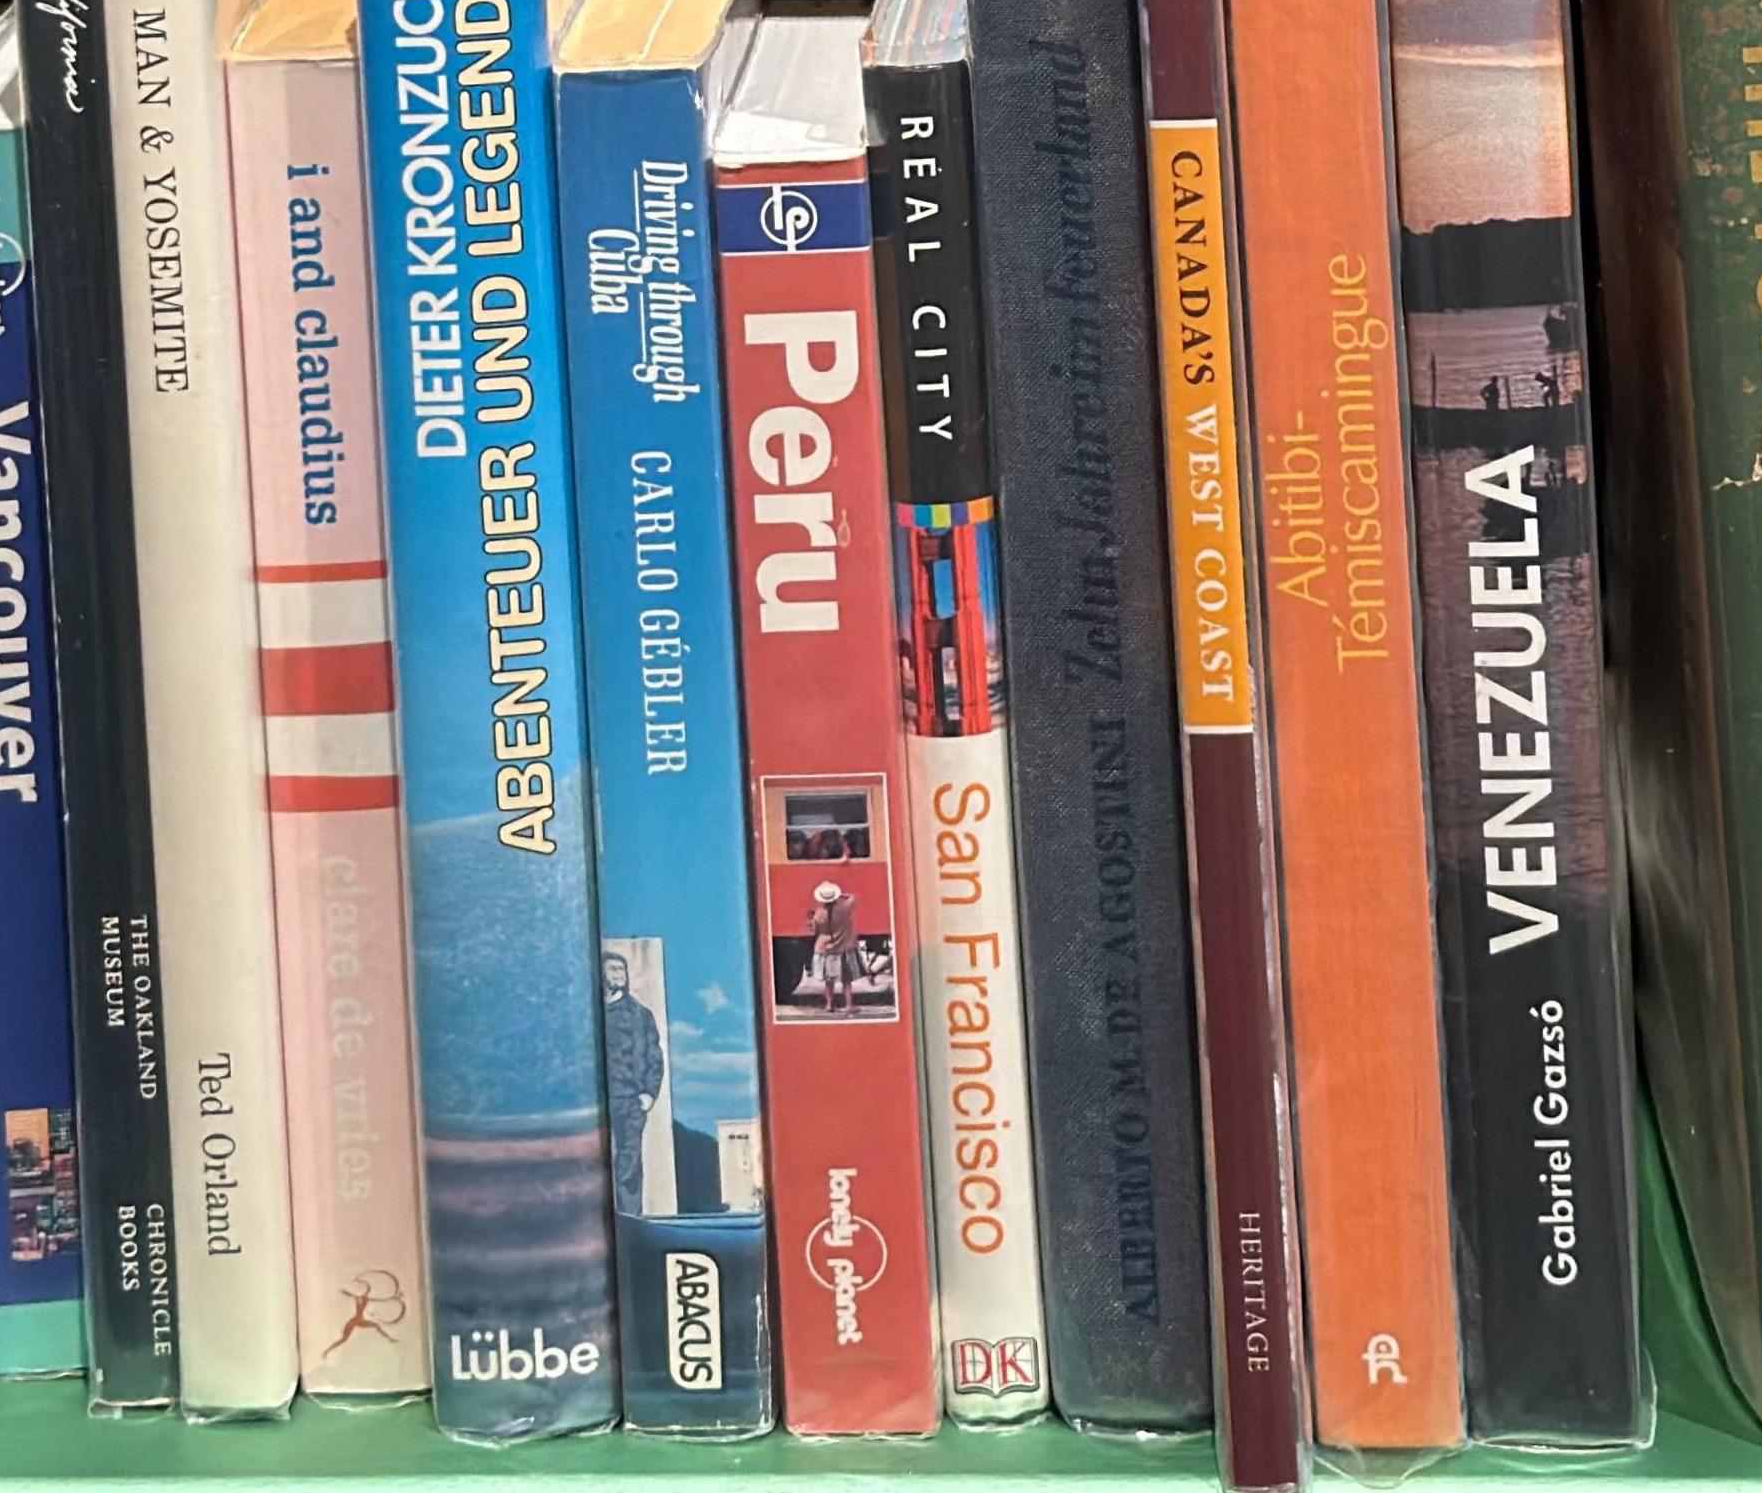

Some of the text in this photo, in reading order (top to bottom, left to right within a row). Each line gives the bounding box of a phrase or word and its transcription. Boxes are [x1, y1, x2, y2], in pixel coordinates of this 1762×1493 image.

[131, 7, 189, 396] MAN YOSEMITE
[586, 226, 628, 319] Cuba
[900, 114, 955, 442] REAL CITY
[289, 194, 343, 526] and claudius
[410, 280, 468, 460] DIETER
[470, 273, 533, 426] UND
[1170, 151, 1234, 703] CANADA'S WEST COAST
[744, 308, 860, 634] Peru
[1264, 410, 1328, 607] Abitibi-
[1328, 252, 1389, 672] Témiscamingue
[477, 441, 558, 856] ABENTEUER
[628, 450, 689, 777] CARLO GÉBLER
[1464, 444, 1559, 955] VENEZUELA
[101, 914, 125, 1029] MUSEUM
[131, 914, 158, 1101] THE OAKLAND
[932, 781, 1012, 1254] San Francisco
[195, 1052, 242, 1259] Ted Orland
[1530, 999, 1578, 1286] Gabriel Gazsó
[120, 1205, 139, 1293] BOOKS
[148, 1203, 171, 1359] CHRONICLE
[669, 1259, 718, 1386] ABACUS
[1239, 1211, 1270, 1372] HERITAGE
[450, 1328, 600, 1384] Lübbe
